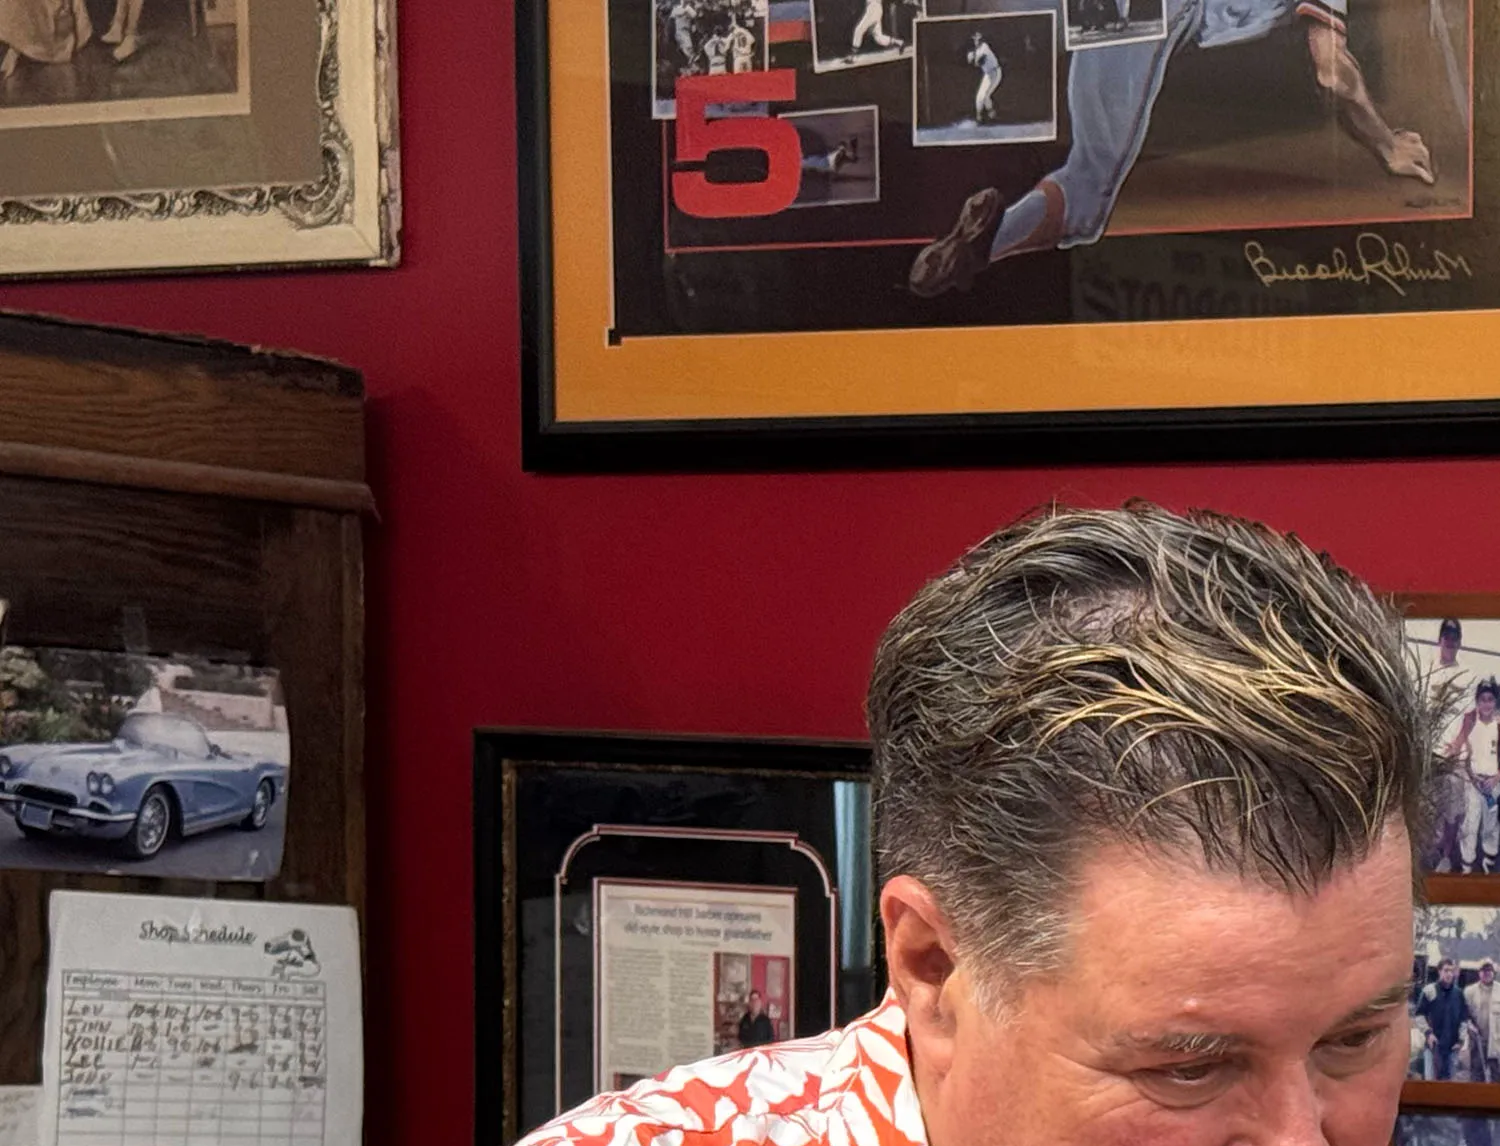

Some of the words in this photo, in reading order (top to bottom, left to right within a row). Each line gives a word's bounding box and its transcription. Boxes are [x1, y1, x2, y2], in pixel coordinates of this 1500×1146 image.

[672, 68, 803, 219] 5
[139, 920, 180, 945] Shop
[179, 923, 258, 944] Shedule
